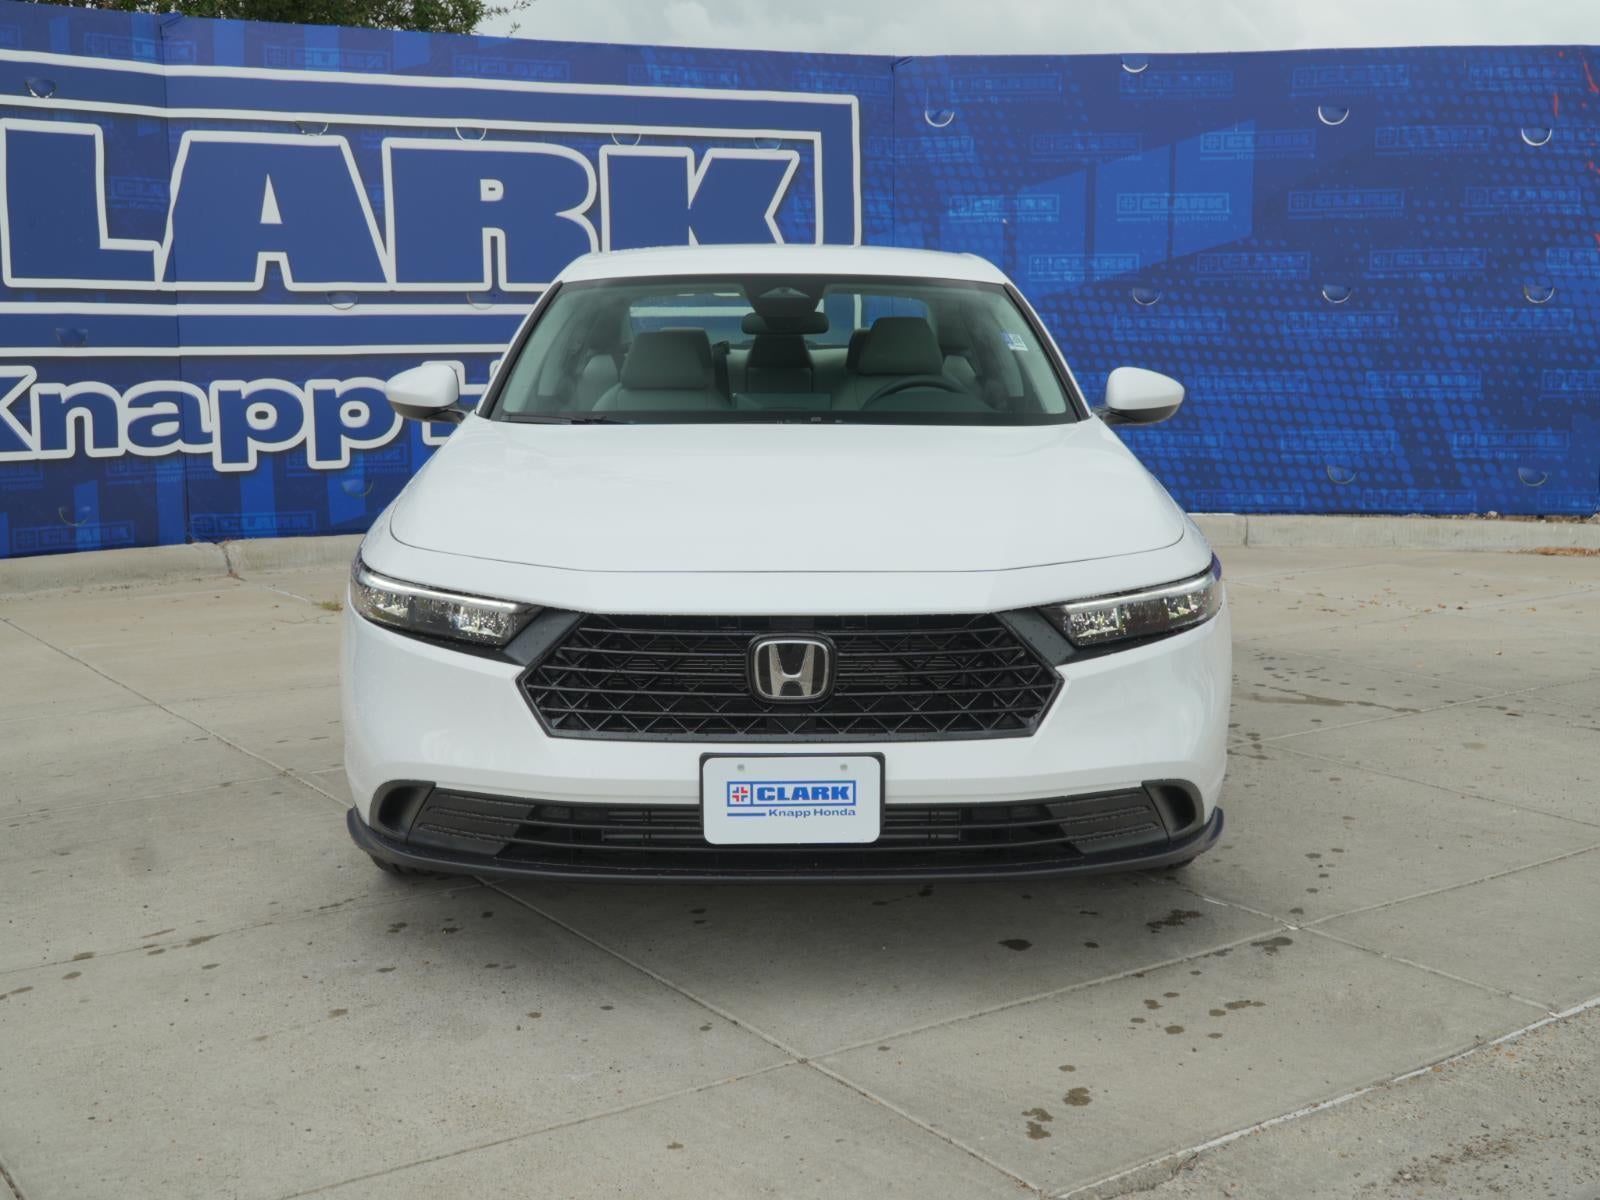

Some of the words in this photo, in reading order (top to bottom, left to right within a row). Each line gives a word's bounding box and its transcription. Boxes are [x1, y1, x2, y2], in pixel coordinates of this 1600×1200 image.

[757, 785, 850, 801] CLARK
[768, 808, 811, 818] Knapp
[813, 807, 856, 817] Honda
